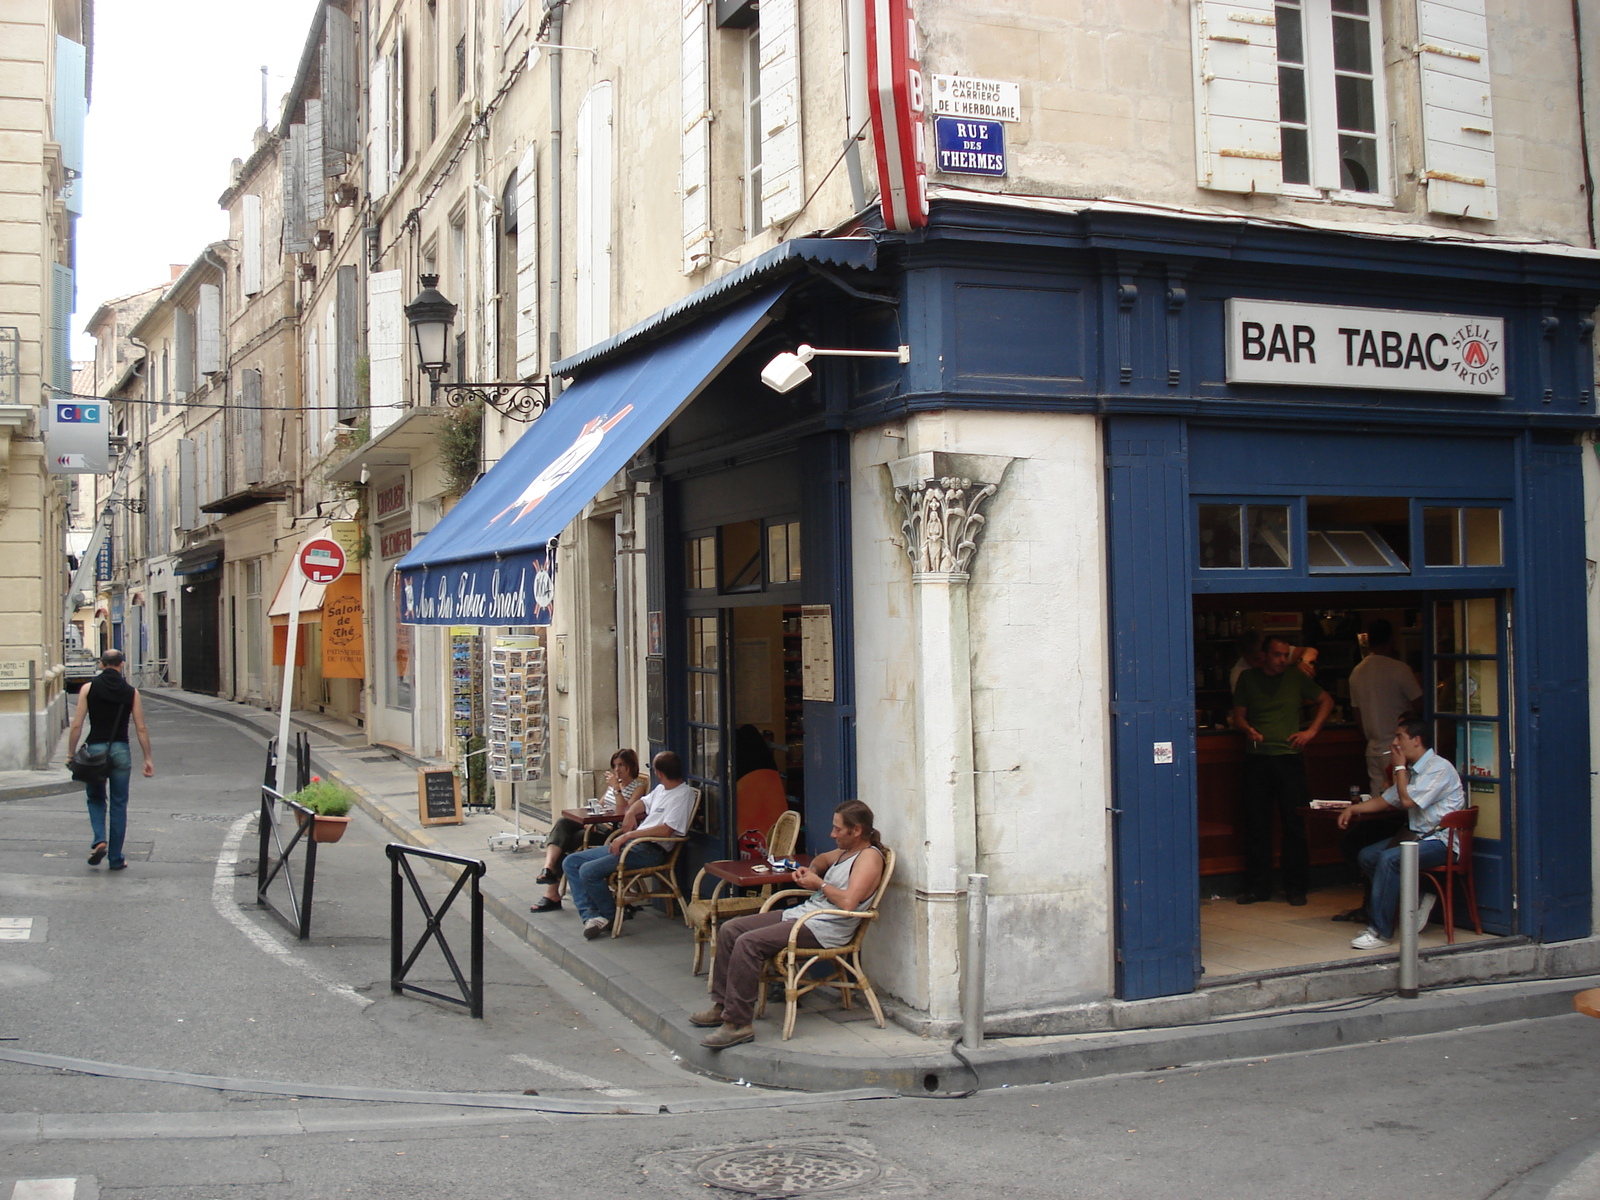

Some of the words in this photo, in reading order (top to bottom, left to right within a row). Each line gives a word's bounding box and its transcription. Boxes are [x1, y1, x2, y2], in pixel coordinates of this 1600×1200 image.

[951, 80, 1000, 92] ANCIENNE
[952, 90, 1000, 102] CARRIERO
[905, 0, 929, 215] ABAC
[939, 100, 949, 111] DE
[957, 123, 988, 140] RUE
[963, 141, 982, 151] DES
[941, 150, 1003, 170] THERMES
[1451, 324, 1499, 353] STELLA
[1242, 321, 1316, 364] BAR
[1338, 327, 1449, 372] TABAC
[1451, 361, 1500, 385] ARTOIS
[60, 407, 97, 420] CIC
[437, 575, 453, 619] Bar
[456, 571, 487, 618] Tabac
[488, 567, 526, 619] Snack
[328, 604, 361, 618] Salon
[337, 616, 351, 626] de
[333, 626, 355, 638] Thé
[340, 656, 362, 664] FORUM
